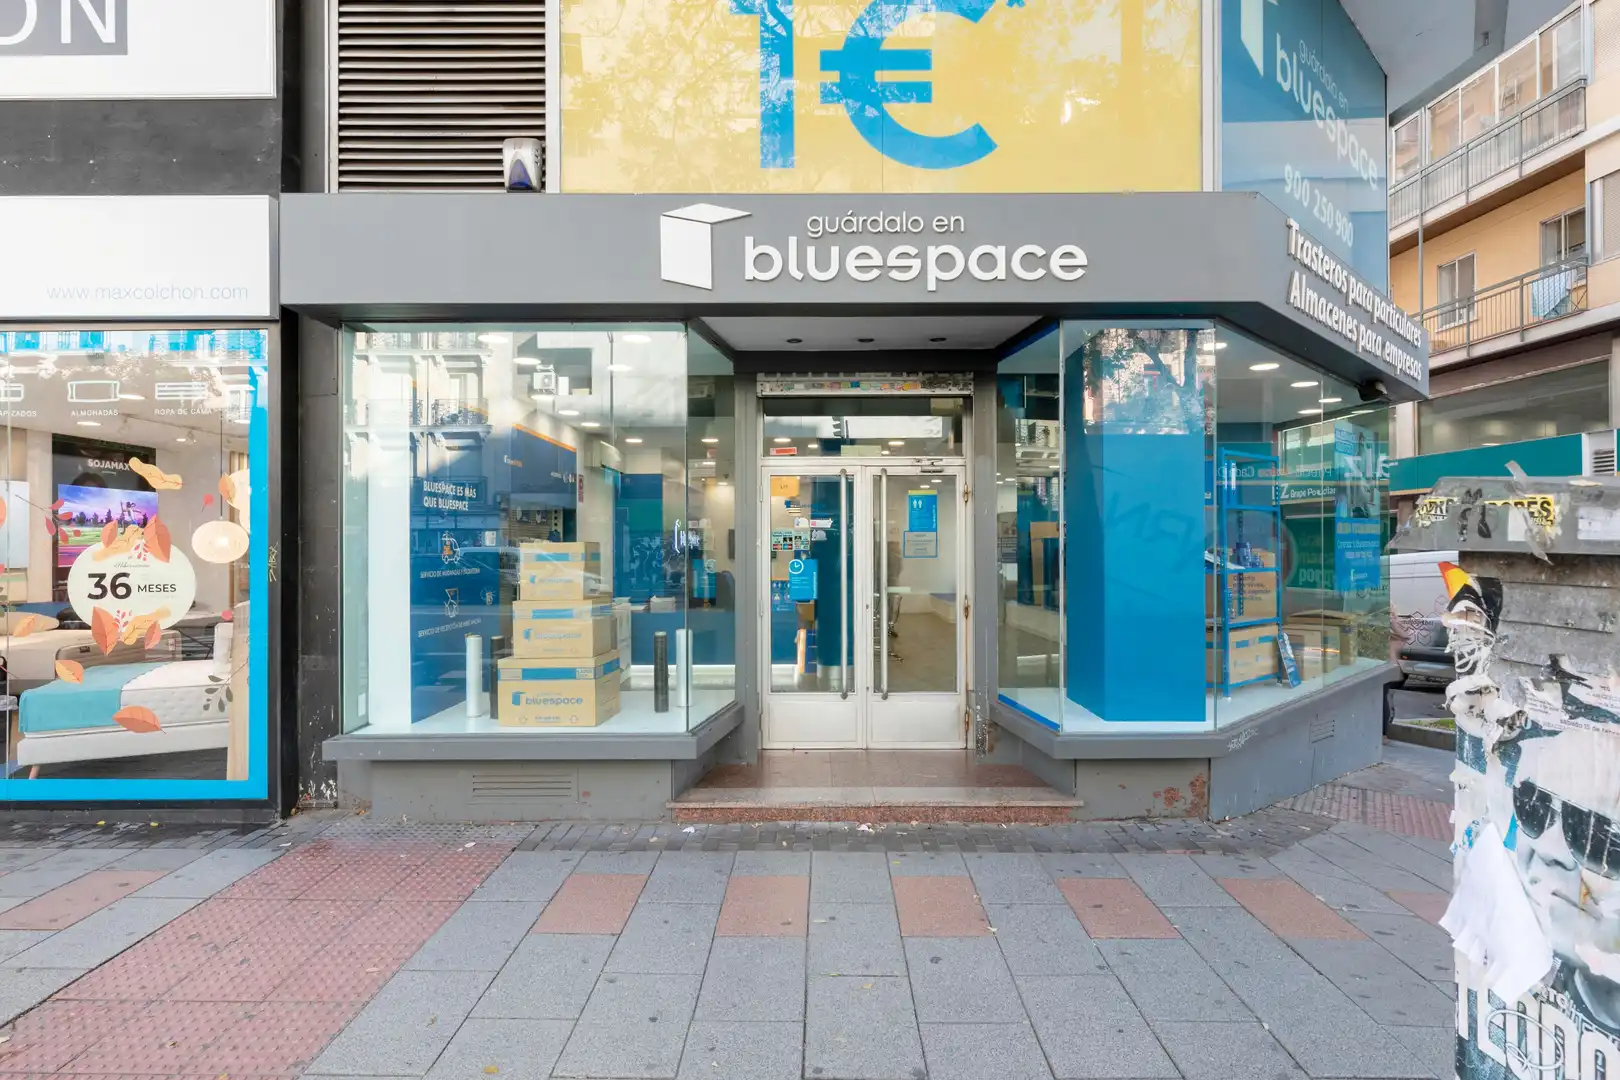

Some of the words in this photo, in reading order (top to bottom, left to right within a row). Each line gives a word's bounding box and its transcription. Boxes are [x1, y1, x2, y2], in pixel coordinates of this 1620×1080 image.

[1299, 39, 1338, 100] guárdalo
[1338, 91, 1349, 114] en
[1276, 31, 1379, 191] bluespace
[1284, 162, 1310, 208] 900
[1312, 188, 1335, 230] 250
[1334, 209, 1354, 248] 900
[806, 210, 925, 238] guárdalo
[932, 215, 965, 233] en
[744, 236, 1089, 292] bluespace
[46, 283, 249, 301] www.maxcolchon.com
[1287, 221, 1349, 294] Trasteros
[1348, 275, 1374, 313] para
[1373, 294, 1422, 348] particulares
[1288, 269, 1359, 342] Almacenes
[1358, 322, 1382, 357] para
[1384, 340, 1423, 381] empresas
[70, 408, 119, 417] ALMOHADAS
[154, 408, 175, 416] ROPA
[87, 458, 130, 471] SOJAMAX
[423, 480, 456, 495] BLUESPACE
[456, 486, 464, 497] ES
[423, 496, 437, 508] QUE
[438, 498, 469, 511] BLUESPACE
[87, 572, 132, 600] 36
[137, 583, 177, 593] MESES
[525, 694, 583, 706] bluespace
